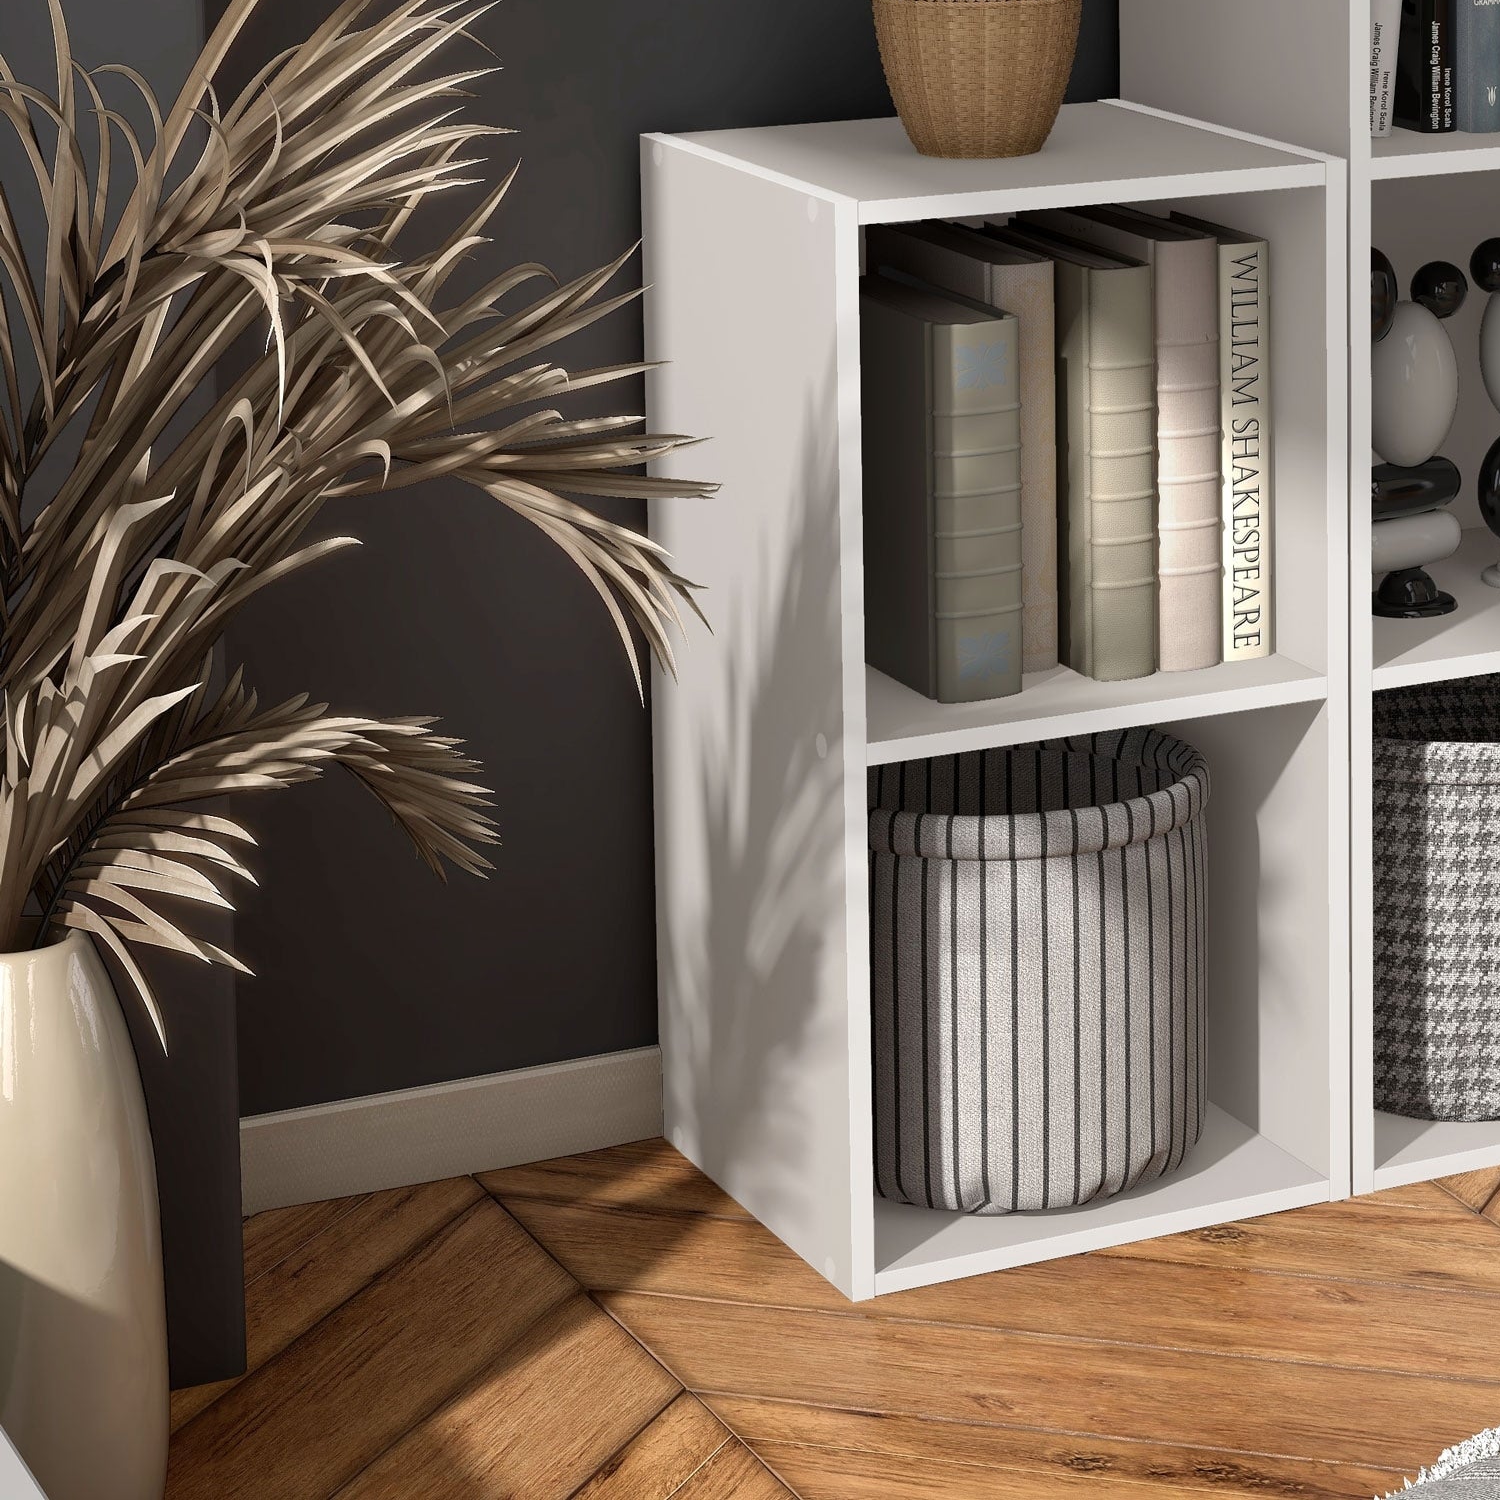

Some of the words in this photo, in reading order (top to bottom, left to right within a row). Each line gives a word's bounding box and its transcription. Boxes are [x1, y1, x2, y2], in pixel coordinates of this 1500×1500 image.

[1373, 22, 1383, 46] James
[1431, 21, 1441, 44] James
[1370, 47, 1381, 67] Craig
[1430, 45, 1441, 65] Craig
[1370, 68, 1380, 94] William
[1432, 66, 1441, 92] William
[1381, 90, 1389, 110] Korol
[1430, 94, 1441, 129] Bevington
[1379, 111, 1387, 131] Scala
[1231, 251, 1259, 408] WILLIAM
[1231, 418, 1261, 650] SHAKESPEARE
